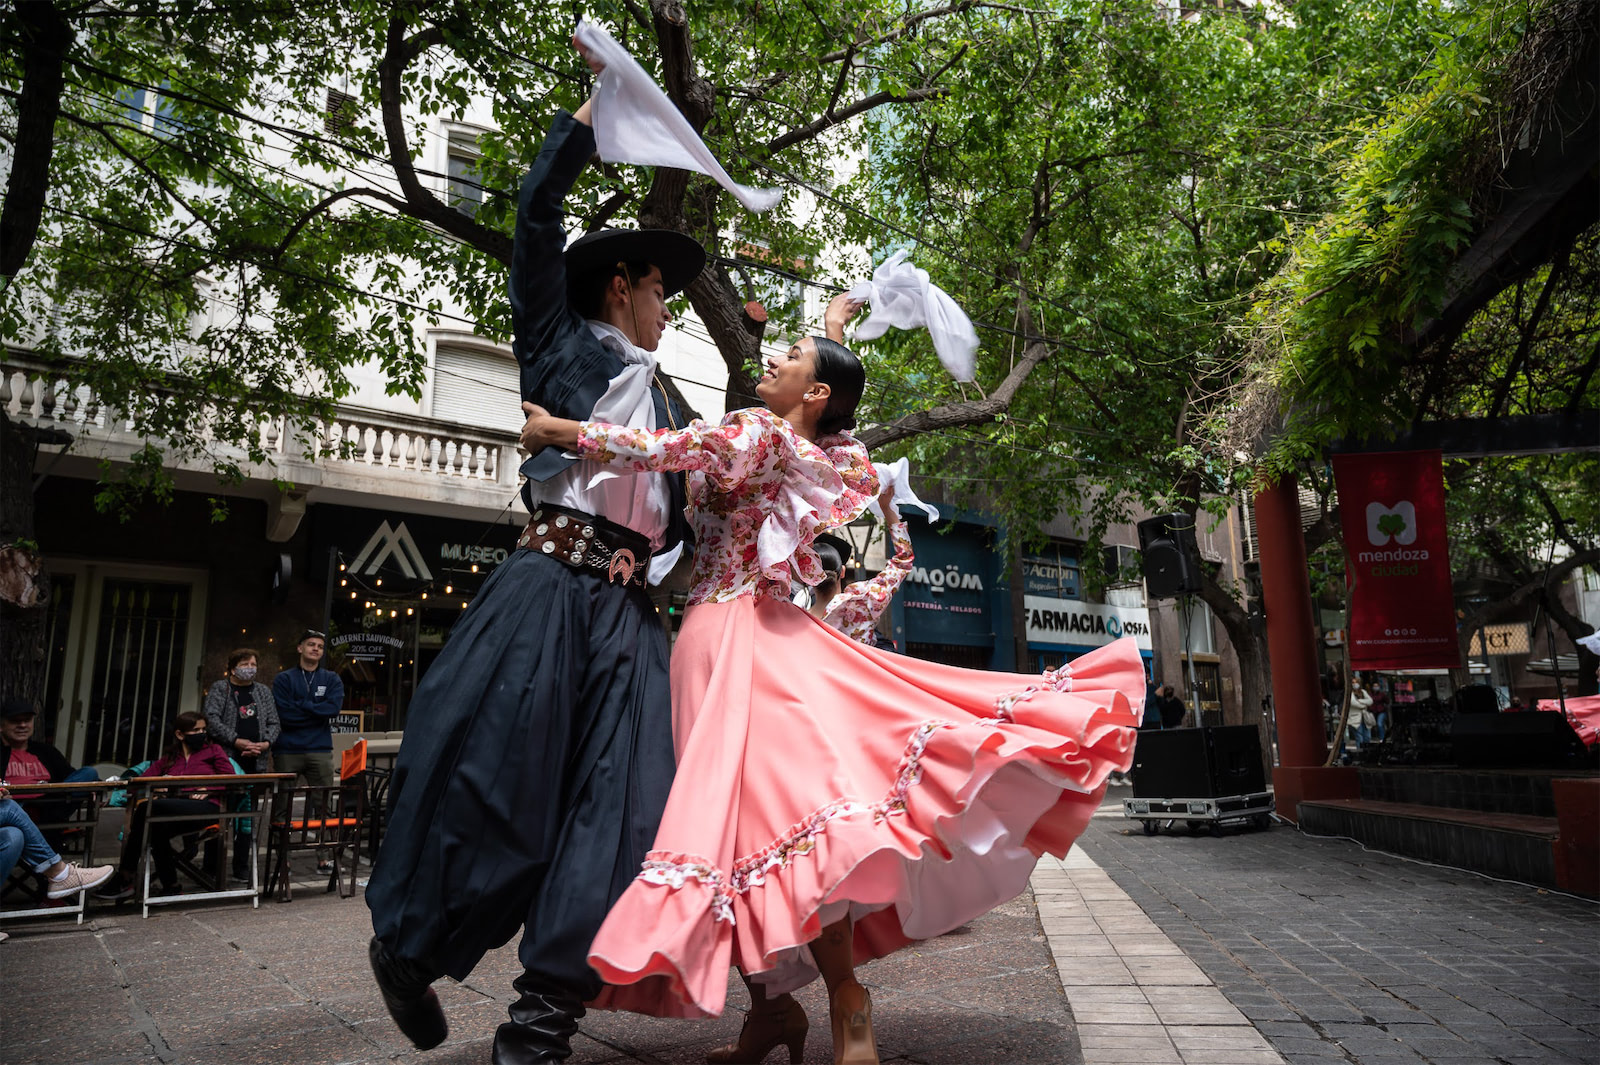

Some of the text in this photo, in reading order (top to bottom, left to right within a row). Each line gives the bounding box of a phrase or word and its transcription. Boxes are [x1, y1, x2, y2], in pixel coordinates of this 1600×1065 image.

[440, 542, 509, 565] MUSEO
[1358, 547, 1430, 563] mendoza
[1371, 562, 1419, 577] ciudad
[950, 605, 982, 615] HELADOS
[1024, 608, 1149, 636] FARMACIA IOSFA
[331, 632, 405, 649] CABERNET SAUVIGNON
[351, 644, 384, 653] 20% OFF
